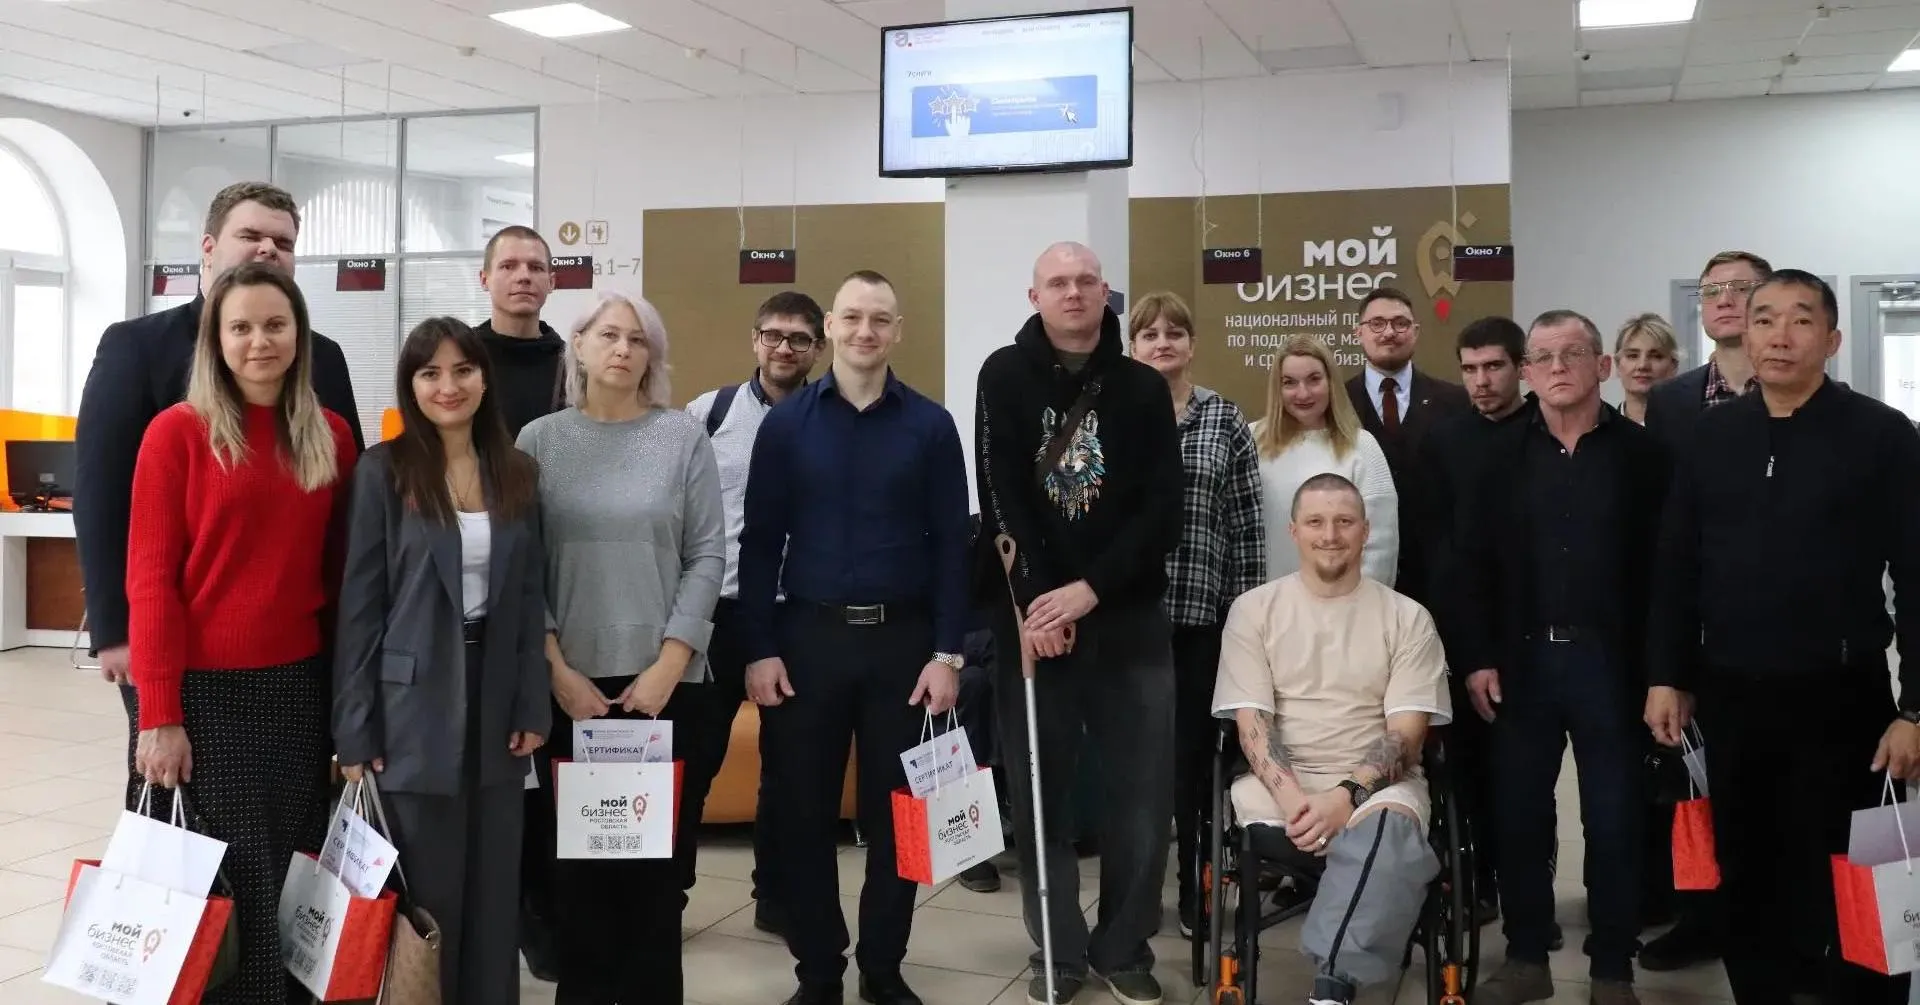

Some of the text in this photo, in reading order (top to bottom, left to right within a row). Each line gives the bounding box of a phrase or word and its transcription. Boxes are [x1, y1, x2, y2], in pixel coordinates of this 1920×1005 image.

[1304, 226, 1397, 267] мой
[1466, 247, 1502, 255] Окно 7
[751, 251, 785, 259] Окно 4
[1214, 250, 1242, 258] Окно
[347, 260, 367, 268] Окно
[551, 257, 583, 266] Окно 3
[162, 266, 184, 274] Окно
[1225, 309, 1337, 329] национальный
[1227, 334, 1246, 347] по
[1245, 354, 1254, 366] и
[581, 805, 627, 817] бизнес
[937, 820, 969, 841] бизнес
[1903, 909, 1920, 923] би
[88, 923, 137, 950] бизнес
